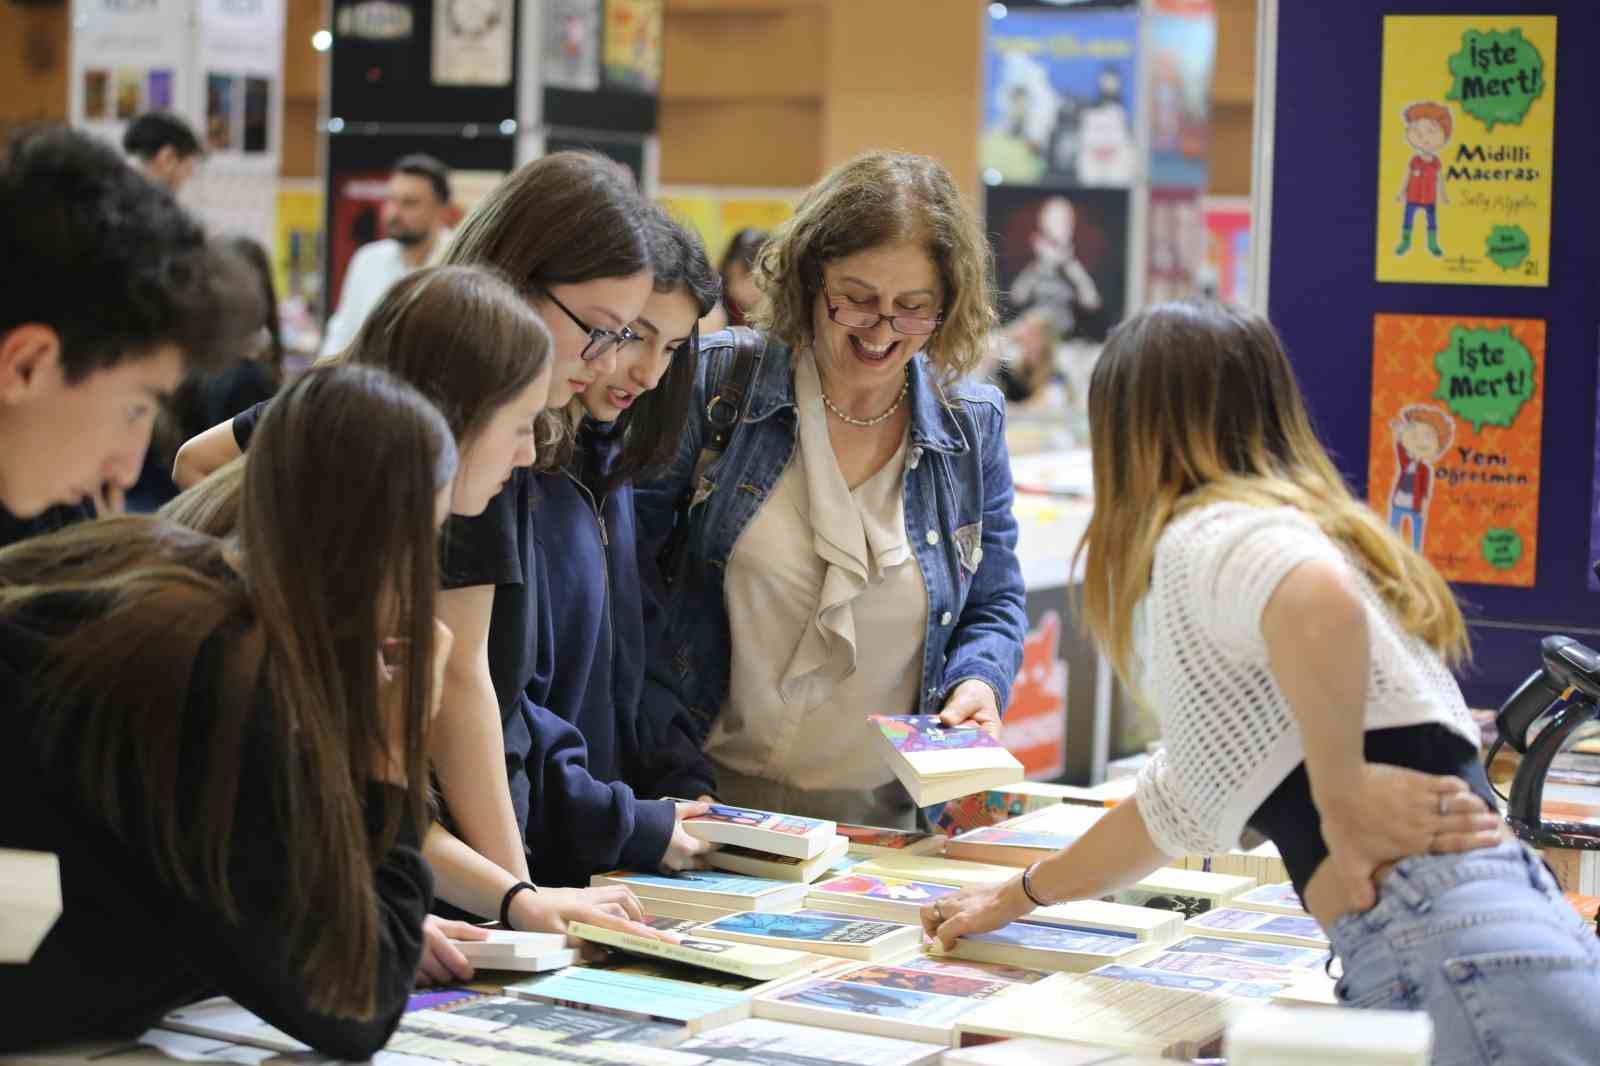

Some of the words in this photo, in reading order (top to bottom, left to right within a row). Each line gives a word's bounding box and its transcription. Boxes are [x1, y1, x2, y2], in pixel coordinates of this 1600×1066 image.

[1461, 66, 1538, 100] Mert!
[1456, 143, 1531, 163] Midilli
[1449, 368, 1526, 398] Mert!
[1457, 446, 1508, 466] Yeni
